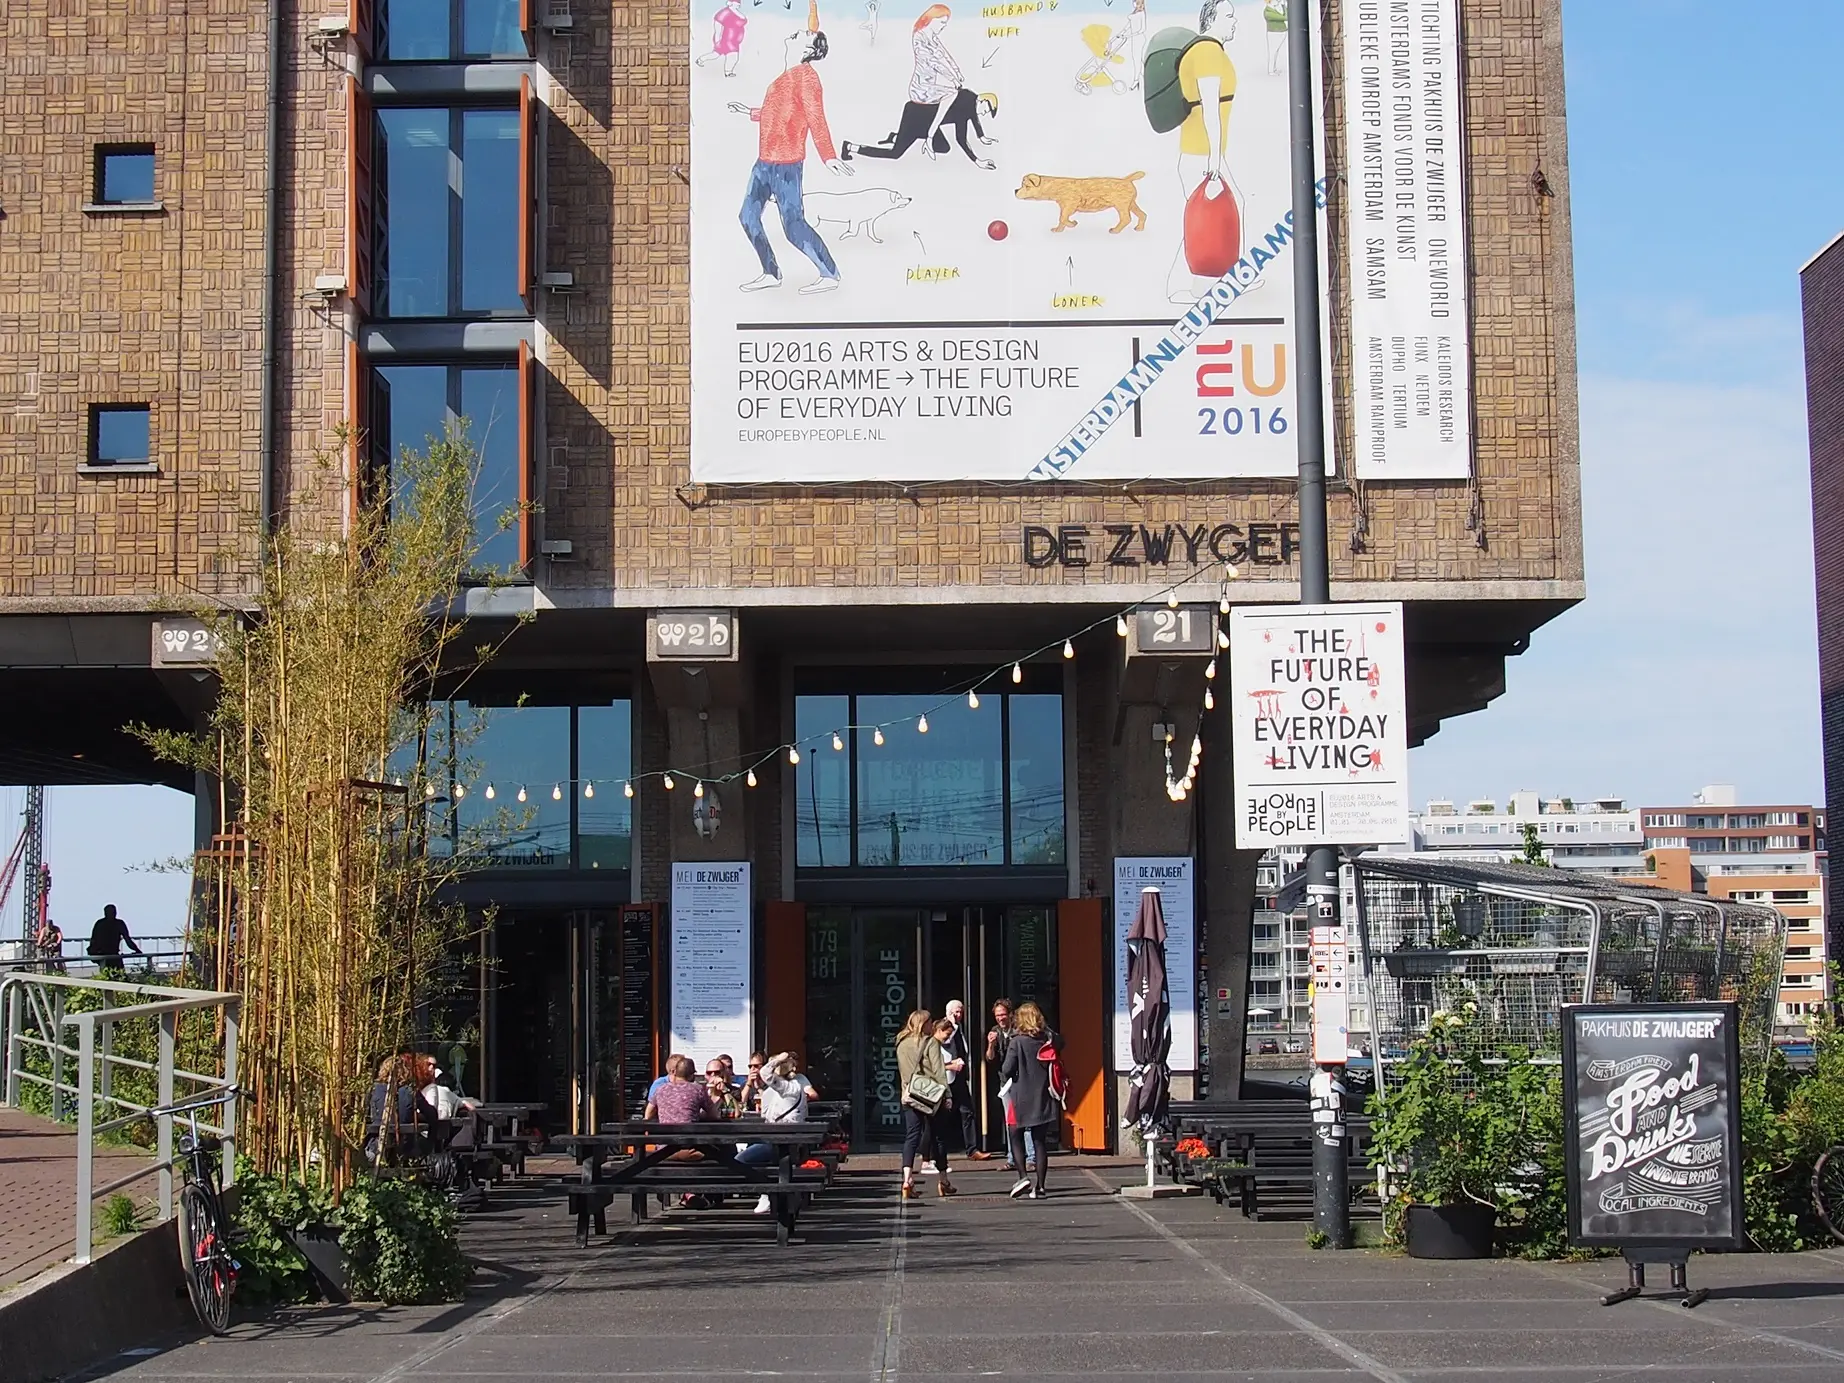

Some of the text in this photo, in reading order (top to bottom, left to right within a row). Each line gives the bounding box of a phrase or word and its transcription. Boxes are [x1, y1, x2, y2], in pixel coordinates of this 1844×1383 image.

[982, 2, 1058, 18] HUSBAND &
[987, 27, 1020, 38] WIFE
[1359, 2, 1384, 221] UBLIEKE OMROEP AMSTERDAM
[1423, 72, 1443, 131] PAKHUIS
[1393, 96, 1412, 141] FONDS
[1425, 138, 1443, 154] DE
[1394, 148, 1414, 186] VOOR
[1396, 193, 1414, 209] DE
[1426, 160, 1445, 222] ZWIJGER
[1397, 216, 1416, 262] KUNST
[1366, 238, 1386, 300] SAMSAM
[1428, 239, 1449, 318] ONEWORLD
[1053, 292, 1103, 308] LONER
[738, 339, 1040, 363] EU2016 ARTS & DESIGN
[1392, 336, 1406, 372] DUPHO
[1414, 336, 1428, 362] FUNX
[738, 367, 1080, 391] PROGRAMME THE FUTURE
[1437, 336, 1454, 443] KALEIDOS RESEARCH
[737, 395, 1012, 419] OF EVERYDAY LIVING
[1369, 336, 1386, 463] AMSTERDAM RAINPROOF
[1393, 384, 1407, 429] TERTIUM
[1416, 375, 1430, 416] NETDEM
[1197, 407, 1288, 435] 2016
[738, 428, 886, 441] EUROPEBYPEOPLE.NL
[1023, 525, 1090, 567] DE
[1153, 610, 1192, 643] 21
[1294, 629, 1345, 653] THE
[1271, 657, 1369, 683] FUTURE
[1302, 687, 1340, 711] OF
[1255, 714, 1388, 741] EVERYDAY
[1272, 745, 1372, 770] LIVING
[1248, 793, 1315, 815] EUROPE
[1276, 811, 1287, 819] BY
[1358, 799, 1398, 807] PROGRAMME
[1248, 816, 1316, 836] PEOPLE
[677, 871, 740, 883] MEI DE ZWIJGER
[1119, 866, 1182, 878] MEI DE ZWIJGER
[811, 929, 837, 952] 179
[812, 956, 837, 978] 181
[1020, 922, 1036, 990] WAREHOUSE
[880, 950, 906, 1028] PEOPLE
[1582, 1021, 1715, 1038] PAKHUIS DE ZWIJGER
[1590, 1056, 1668, 1079] AMSTERDAM FINEST
[1607, 1053, 1699, 1137] Food
[1636, 1107, 1668, 1132] AND
[1585, 1105, 1697, 1180] Drinks
[1666, 1139, 1722, 1165] WE SERVE
[1639, 1161, 1719, 1184] INDIE BRANDS
[1602, 1193, 1706, 1213] LOCAL INGREDIENTS
